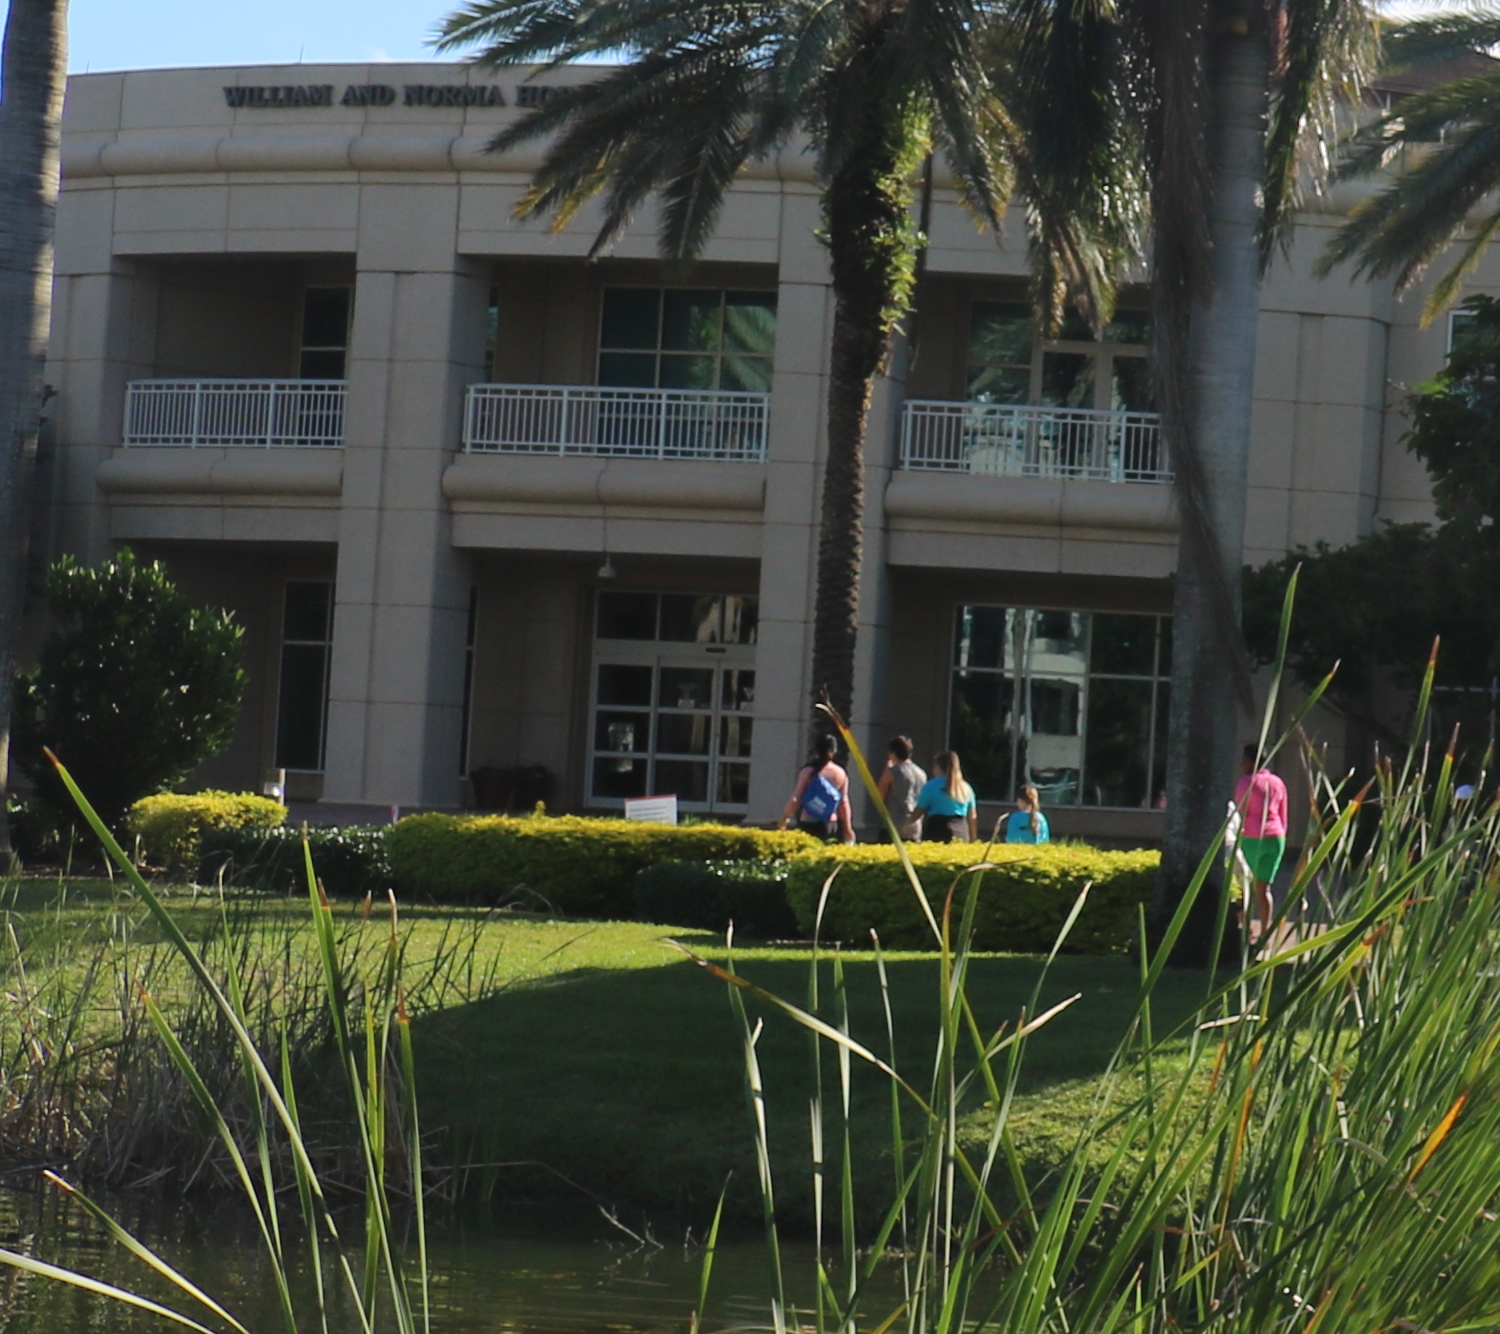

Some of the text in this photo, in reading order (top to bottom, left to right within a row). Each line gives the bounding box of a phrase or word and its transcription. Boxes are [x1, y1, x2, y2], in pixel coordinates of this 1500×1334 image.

[222, 84, 334, 108] WILLIAM
[339, 84, 396, 108] AND
[402, 84, 507, 108] NORMA
